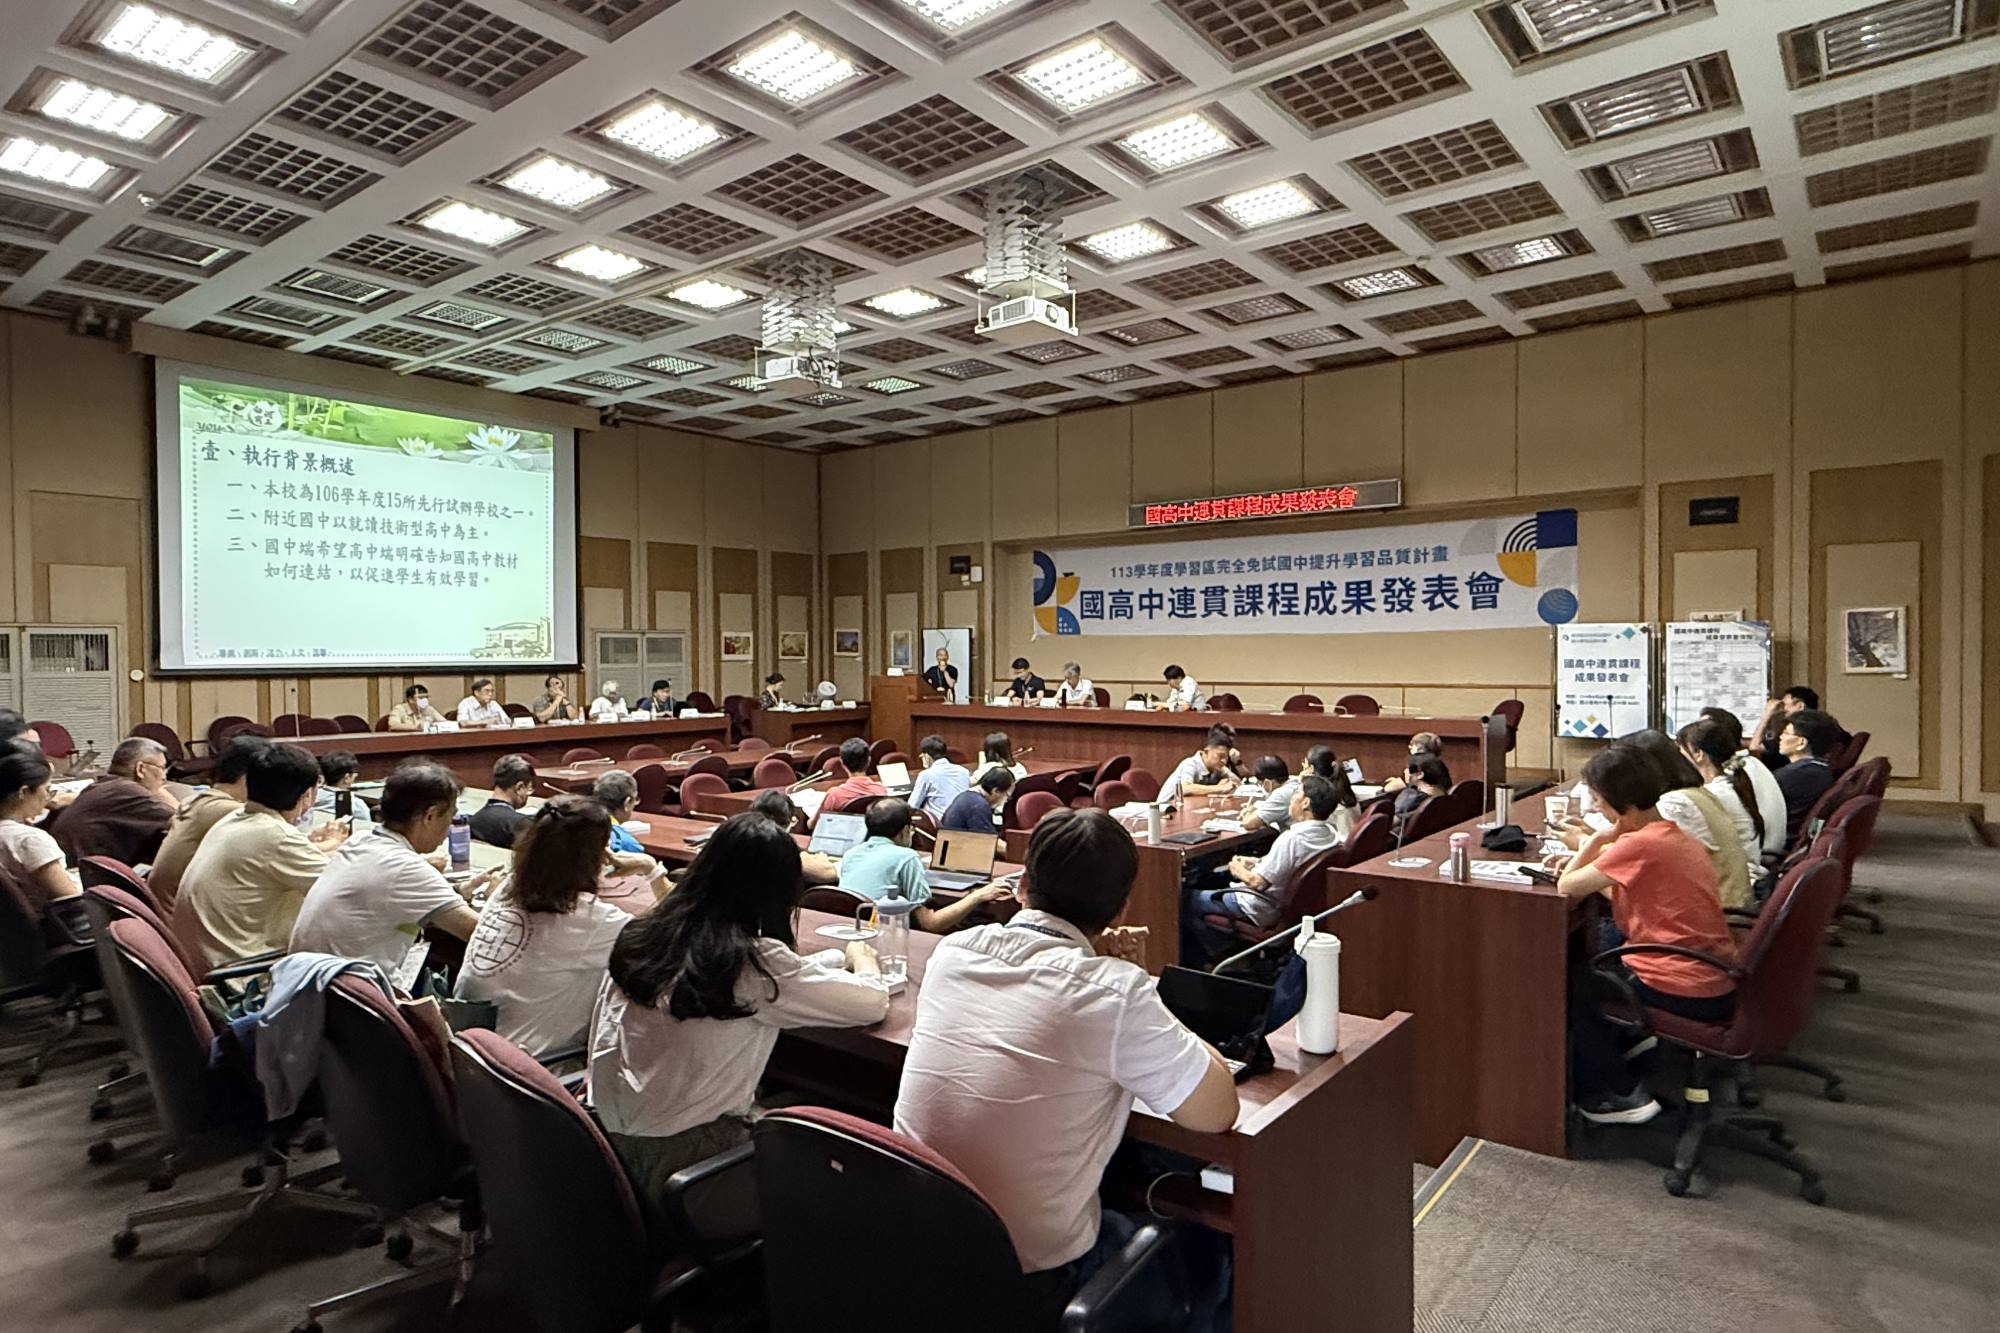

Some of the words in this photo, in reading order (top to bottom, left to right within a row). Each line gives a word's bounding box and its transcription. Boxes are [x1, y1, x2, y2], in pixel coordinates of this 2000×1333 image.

[201, 440, 356, 476] 壹、執行背景概述
[1145, 486, 1358, 524] 國高中連貫課程成果發表會
[1110, 545, 1449, 579] 113學年度學習區完全免試國中提升學習品質計畫
[1079, 570, 1505, 620] 國高中連貫課程成果發表會
[1563, 658, 1641, 670] 國高中連貫課程
[1574, 672, 1629, 683] 成果發表會
